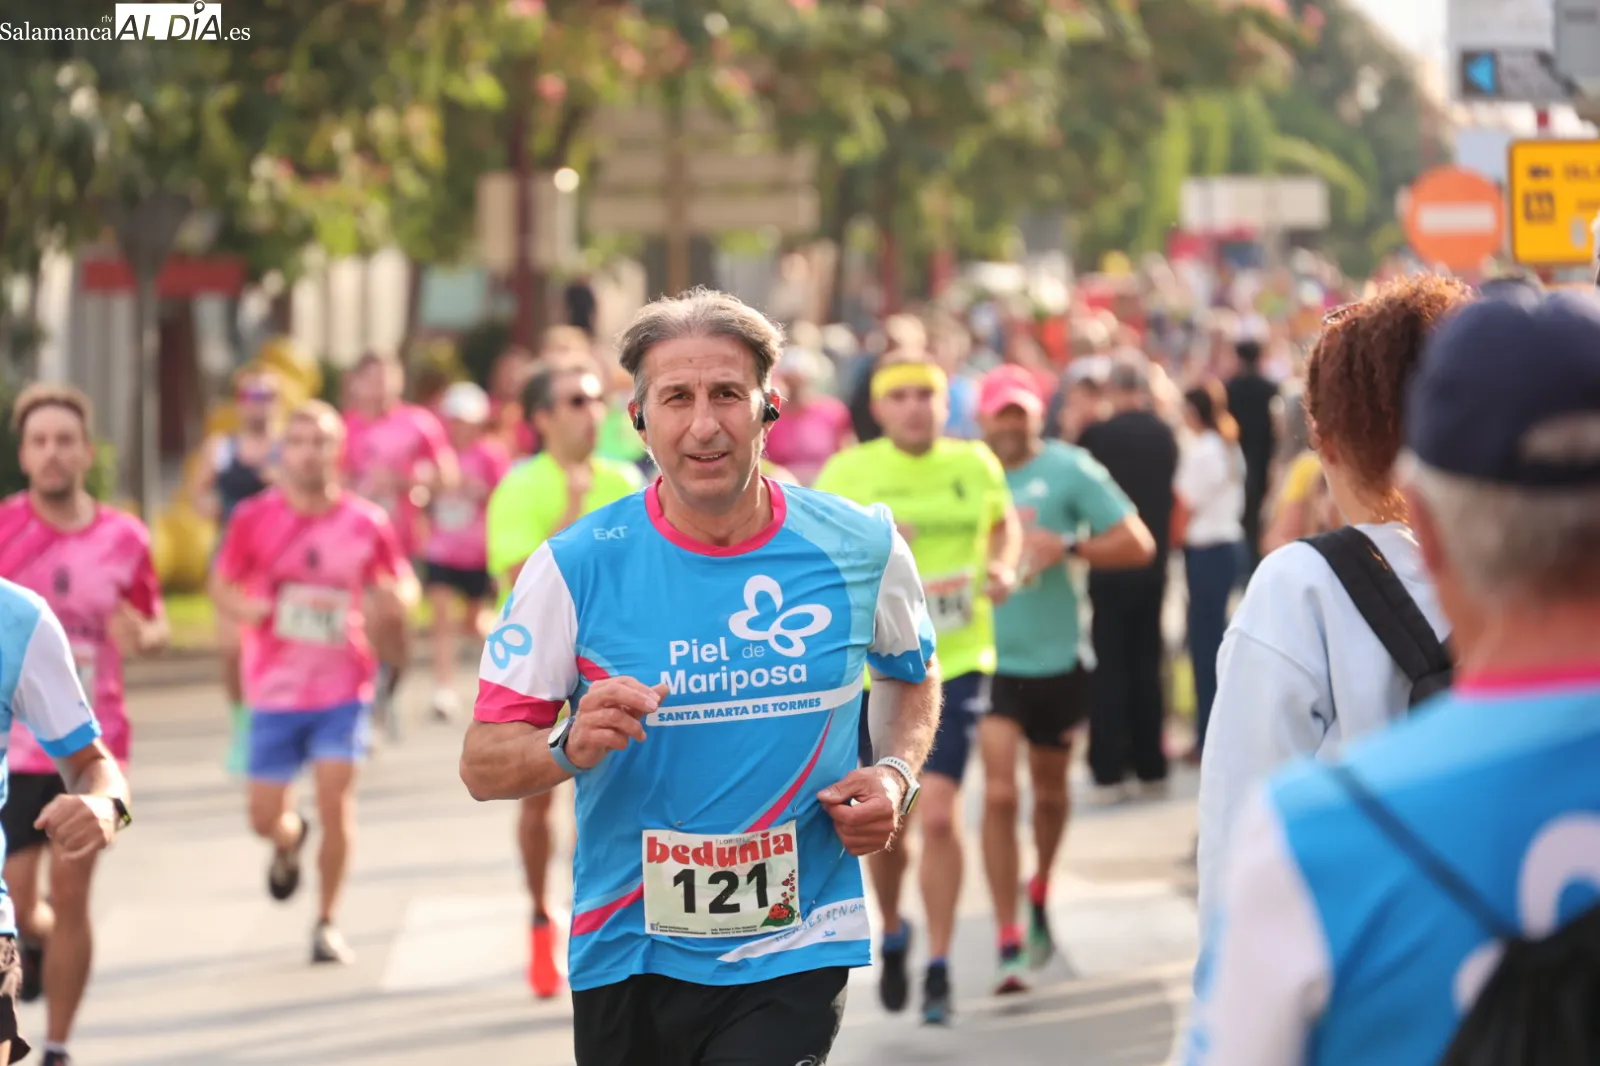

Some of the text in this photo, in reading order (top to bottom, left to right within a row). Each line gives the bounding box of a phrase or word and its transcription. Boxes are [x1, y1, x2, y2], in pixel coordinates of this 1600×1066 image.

[592, 525, 628, 541] EKT
[669, 637, 765, 666] Piel de
[659, 663, 807, 696] Mariposa
[658, 697, 821, 722] SANTA MARTA DE TORMES
[647, 831, 793, 868] bedunia
[673, 862, 769, 915] 121
